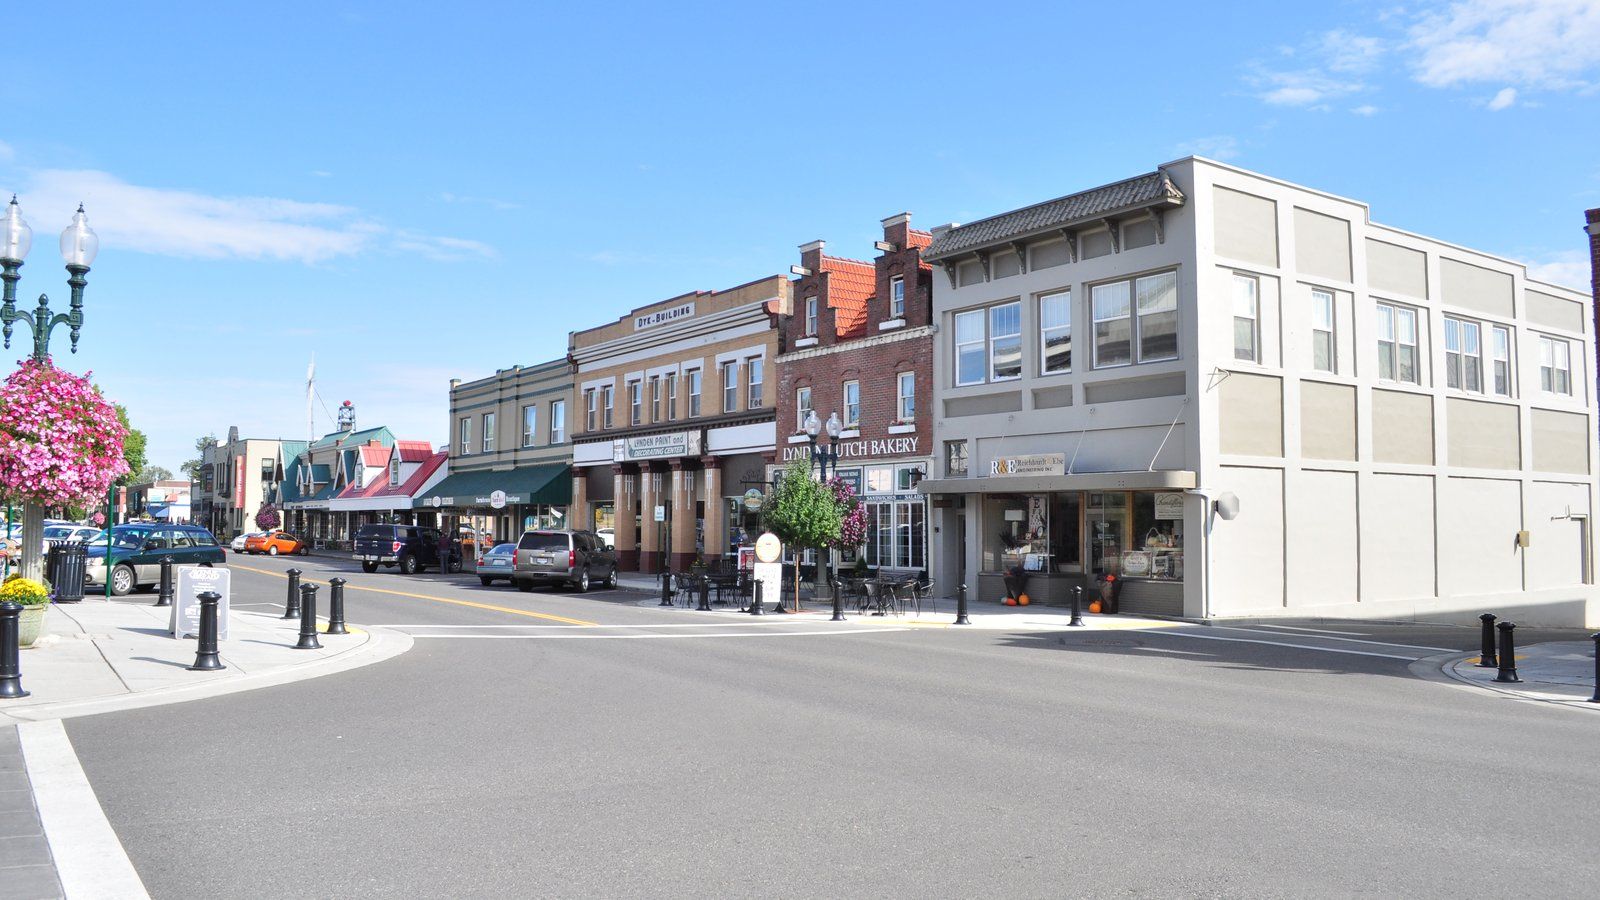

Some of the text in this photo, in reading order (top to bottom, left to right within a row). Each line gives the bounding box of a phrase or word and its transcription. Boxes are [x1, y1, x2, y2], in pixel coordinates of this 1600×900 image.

[634, 437, 654, 447] LYNDEN
[655, 435, 671, 446] PAINT
[871, 436, 919, 455] BAKERY
[634, 446, 684, 457] DECORATING CENTER
